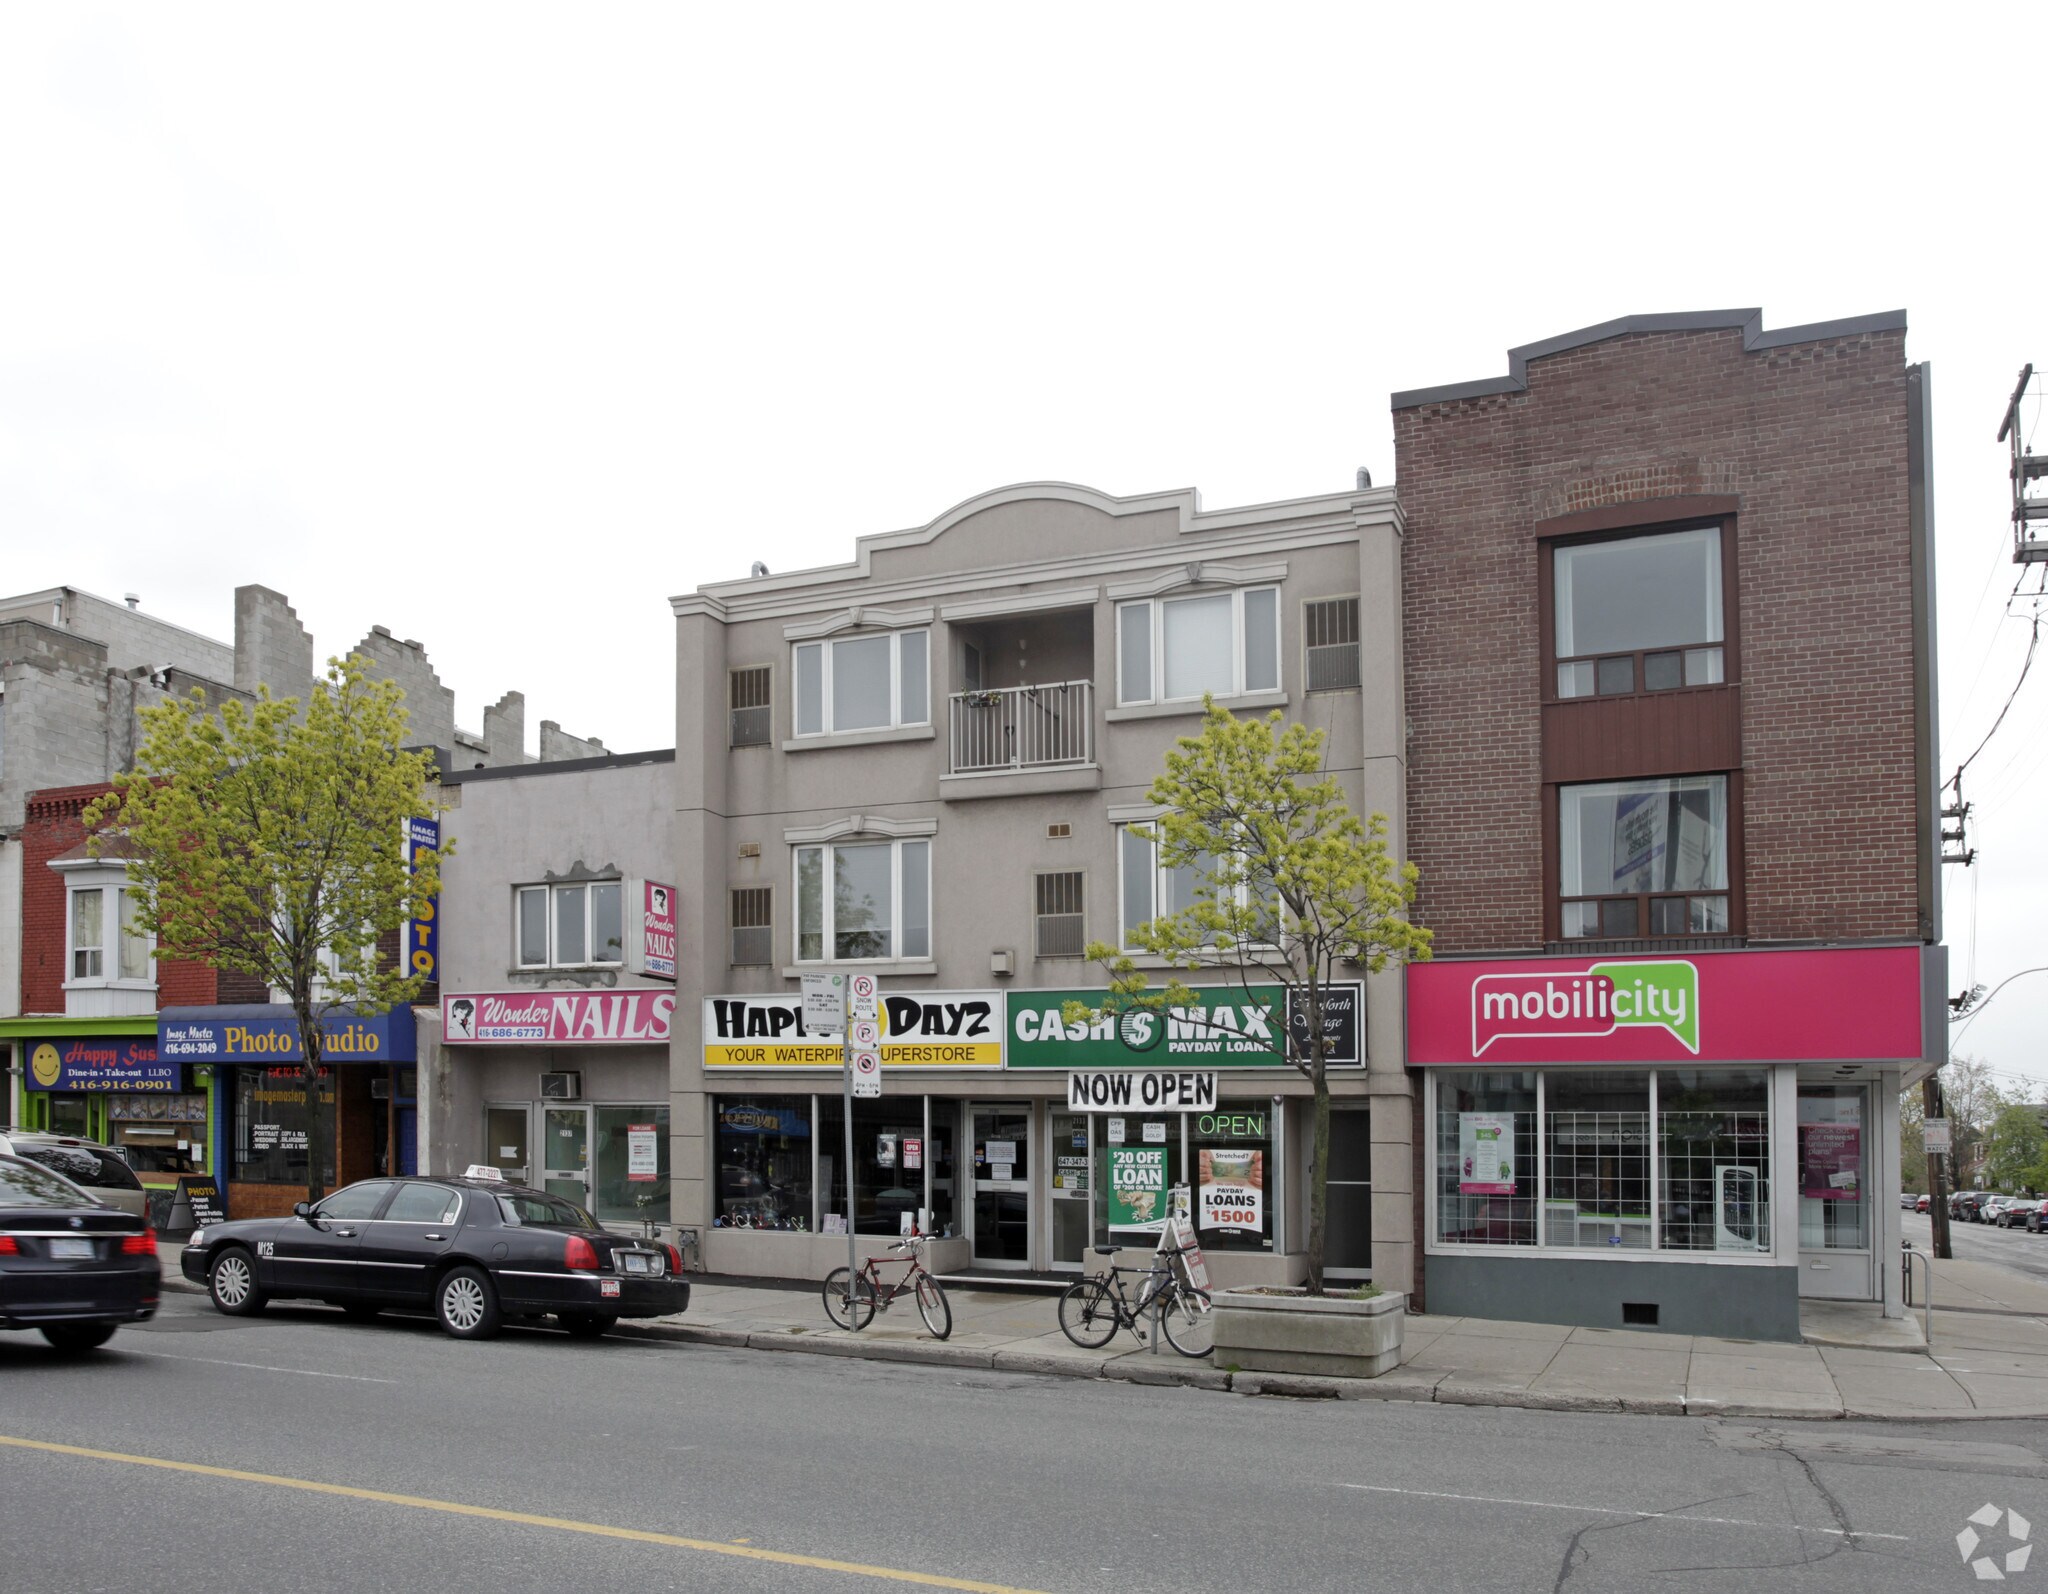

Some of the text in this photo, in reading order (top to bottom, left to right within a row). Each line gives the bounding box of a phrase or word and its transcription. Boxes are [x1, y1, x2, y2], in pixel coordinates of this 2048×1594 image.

[412, 824, 436, 838] IMAGE
[411, 832, 437, 846] MASTER
[645, 911, 674, 933] Wonder
[645, 931, 675, 959] NAILS
[1483, 979, 1686, 1026] mobilicity
[482, 993, 677, 1039] Wonder NAILS
[884, 996, 991, 1037] DAYZ
[1015, 1006, 1115, 1042] CASH
[1167, 1005, 1273, 1040] MAX
[166, 1026, 213, 1041] Image Master
[224, 1026, 292, 1053] Photo
[165, 1042, 217, 1054] 416-694-2049
[725, 1047, 975, 1062] YOUR WATERPIP UPERSTORE
[1169, 1041, 1274, 1053] PAYDAY LOANS
[64, 1042, 117, 1068] Happy
[67, 1068, 172, 1077] Dine-in Take-out LLBO
[68, 1080, 173, 1090] 416-916-0901
[1072, 1072, 1213, 1106] NOW OPEN
[1199, 1115, 1262, 1136] OPEN
[1073, 1130, 1087, 1138] OPEN
[1113, 1151, 1162, 1164] $20 OFF
[1113, 1169, 1163, 1185] LOAN
[187, 1187, 216, 1196] PHOTO
[1205, 1194, 1256, 1206] LOANS
[257, 1241, 274, 1256] M125
